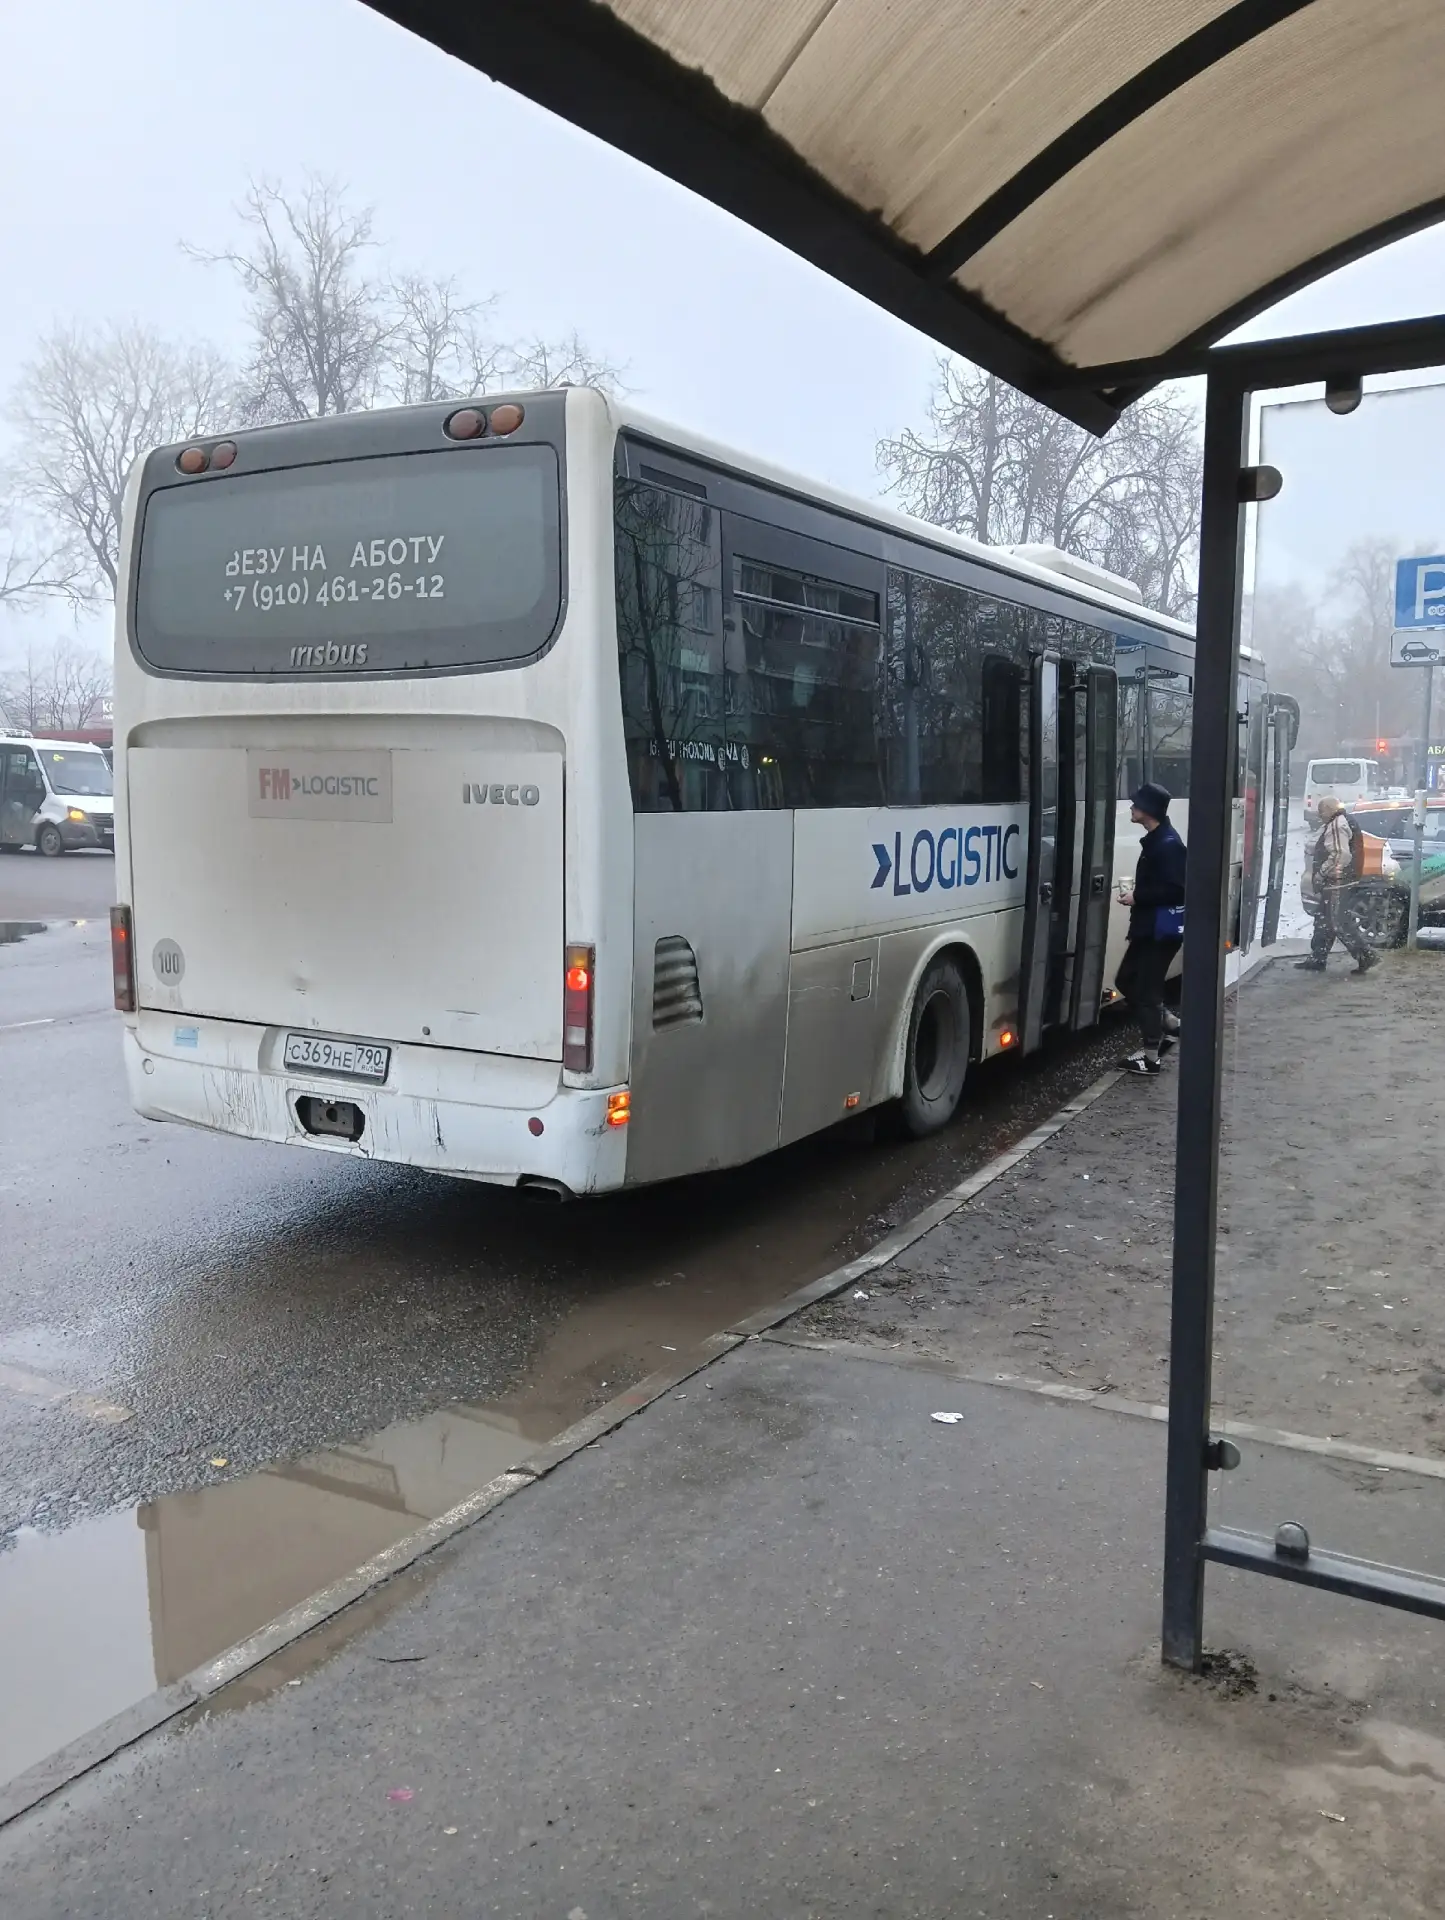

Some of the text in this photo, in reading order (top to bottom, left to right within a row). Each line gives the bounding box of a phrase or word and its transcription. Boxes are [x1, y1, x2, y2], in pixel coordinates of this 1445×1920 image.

[291, 545, 327, 571] НА
[252, 577, 309, 611] (910)
[315, 572, 444, 606] 461-26-12
[290, 641, 368, 667] irisbus
[259, 768, 379, 800] FM LOGISTIC
[462, 783, 541, 806] IVECO
[893, 823, 1020, 897] LOGISTIC
[158, 951, 180, 975] 100
[357, 1047, 382, 1066] 790
